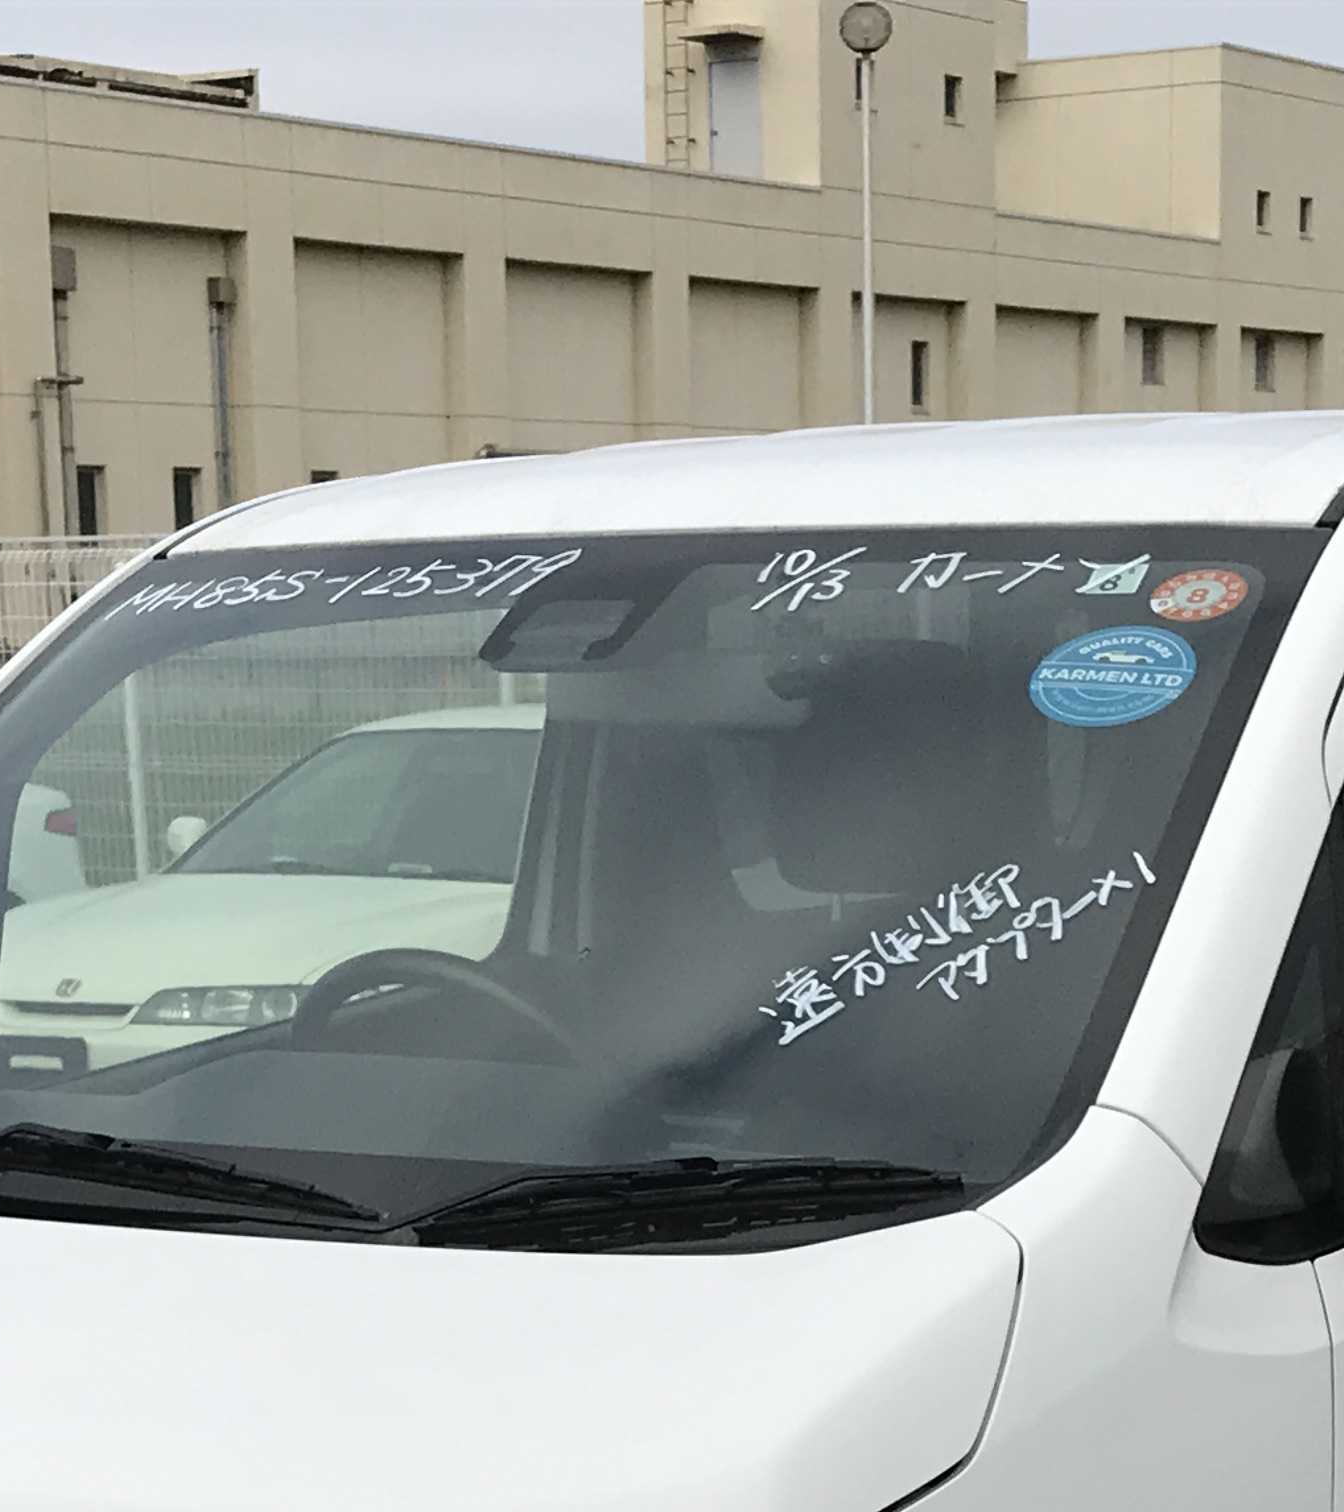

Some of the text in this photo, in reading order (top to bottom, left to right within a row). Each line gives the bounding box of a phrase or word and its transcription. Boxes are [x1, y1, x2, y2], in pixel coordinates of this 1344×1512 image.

[105, 547, 583, 621] MH85S-125379
[750, 546, 867, 612] 10/13
[1078, 635, 1174, 660] QUALITY CARS
[1038, 666, 1184, 688] KARMEN LTD
